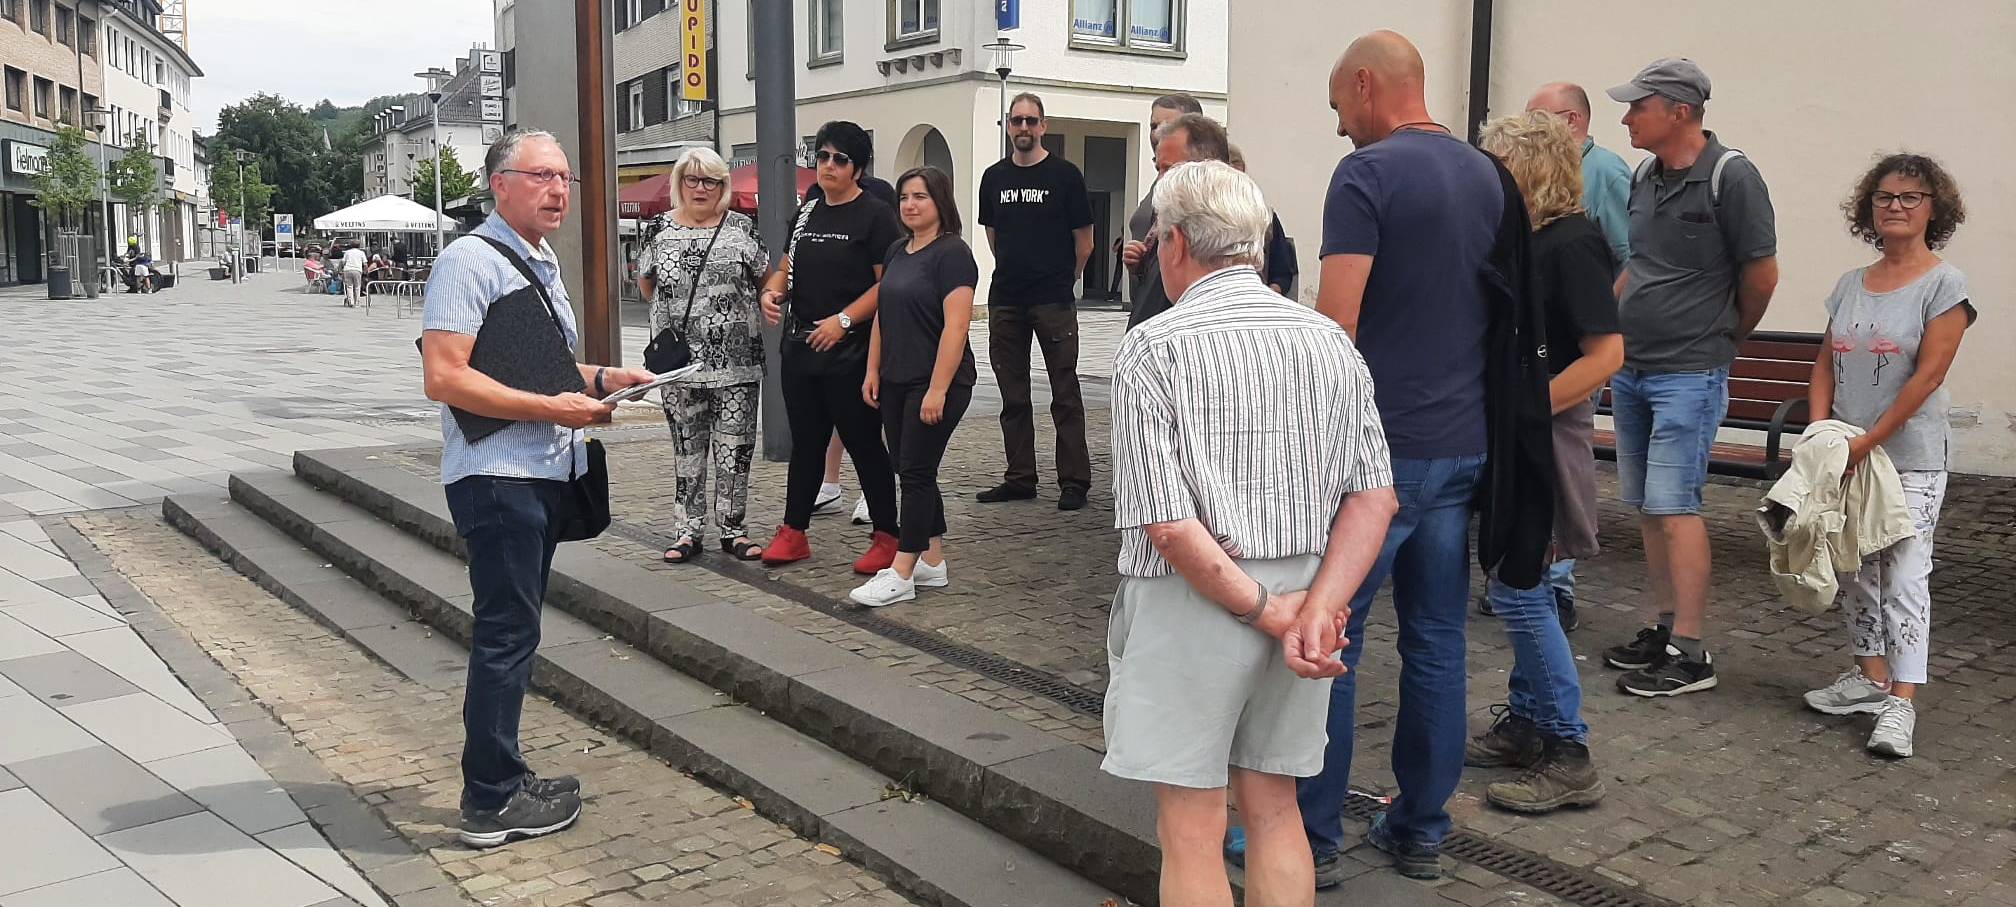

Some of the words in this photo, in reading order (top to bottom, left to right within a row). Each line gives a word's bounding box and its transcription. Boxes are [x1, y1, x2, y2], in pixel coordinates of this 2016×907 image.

[1073, 18, 1103, 33] Allianz
[1130, 25, 1159, 38] Allianz
[1000, 188, 1019, 204] NEW
